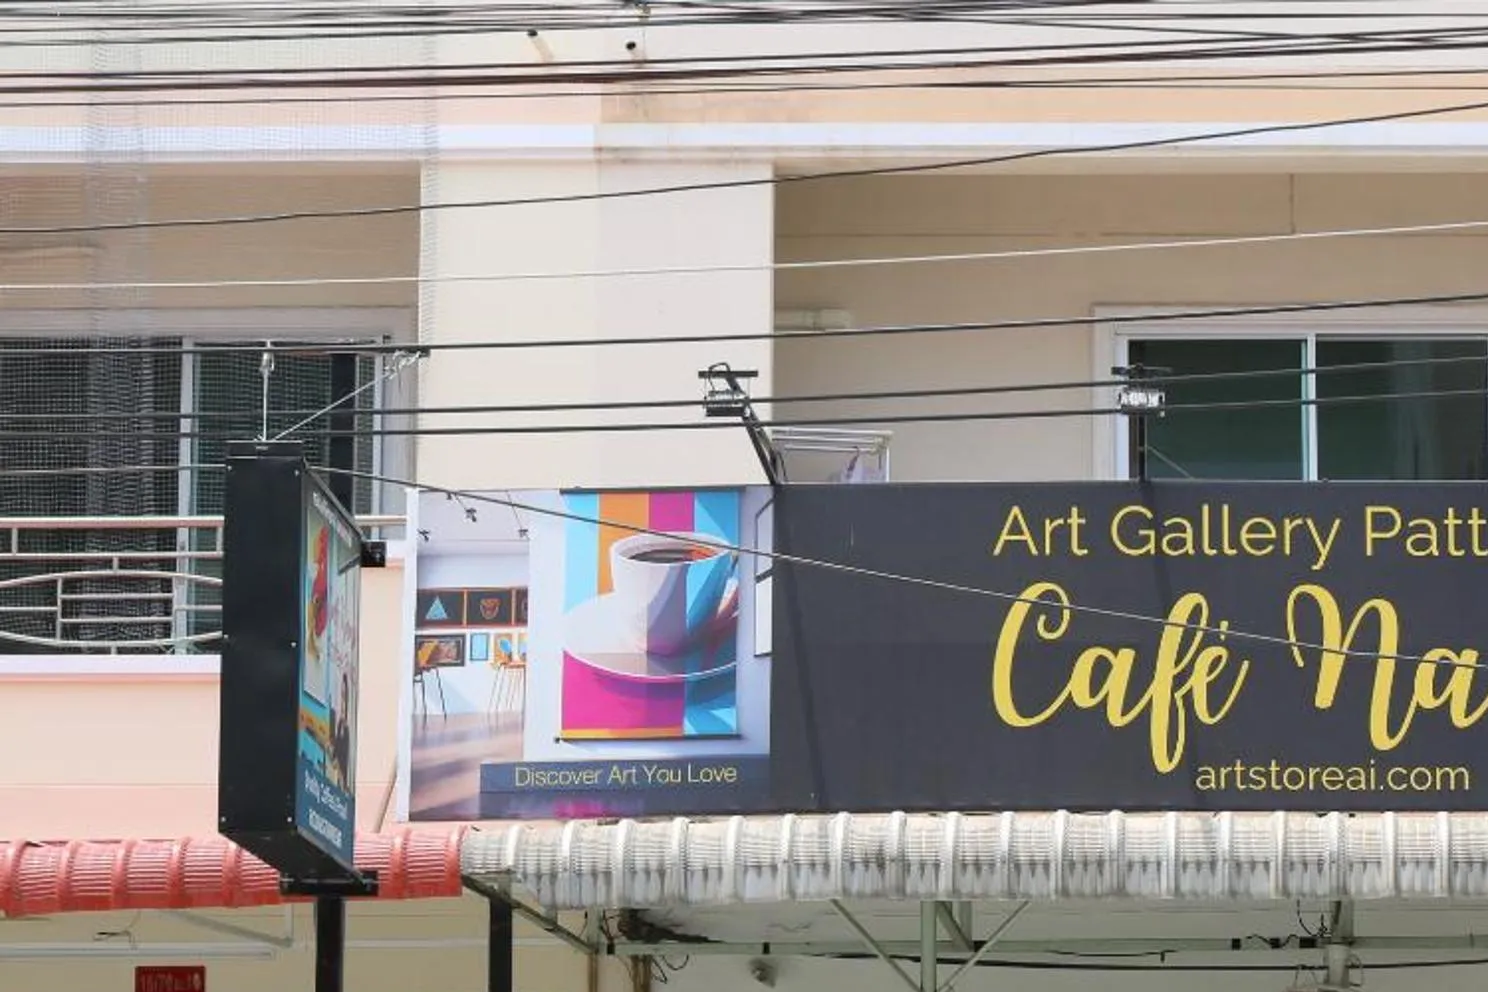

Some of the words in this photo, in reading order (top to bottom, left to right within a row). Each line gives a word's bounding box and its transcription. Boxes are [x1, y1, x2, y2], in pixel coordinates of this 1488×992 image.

[993, 504, 1089, 557] Art
[1109, 503, 1342, 571] Gallery
[992, 581, 1250, 774] Café
[514, 765, 602, 787] Discover
[606, 764, 637, 785] Art
[642, 763, 682, 784] You
[687, 763, 738, 783] Love
[1195, 760, 1470, 792] artstoreai.com
